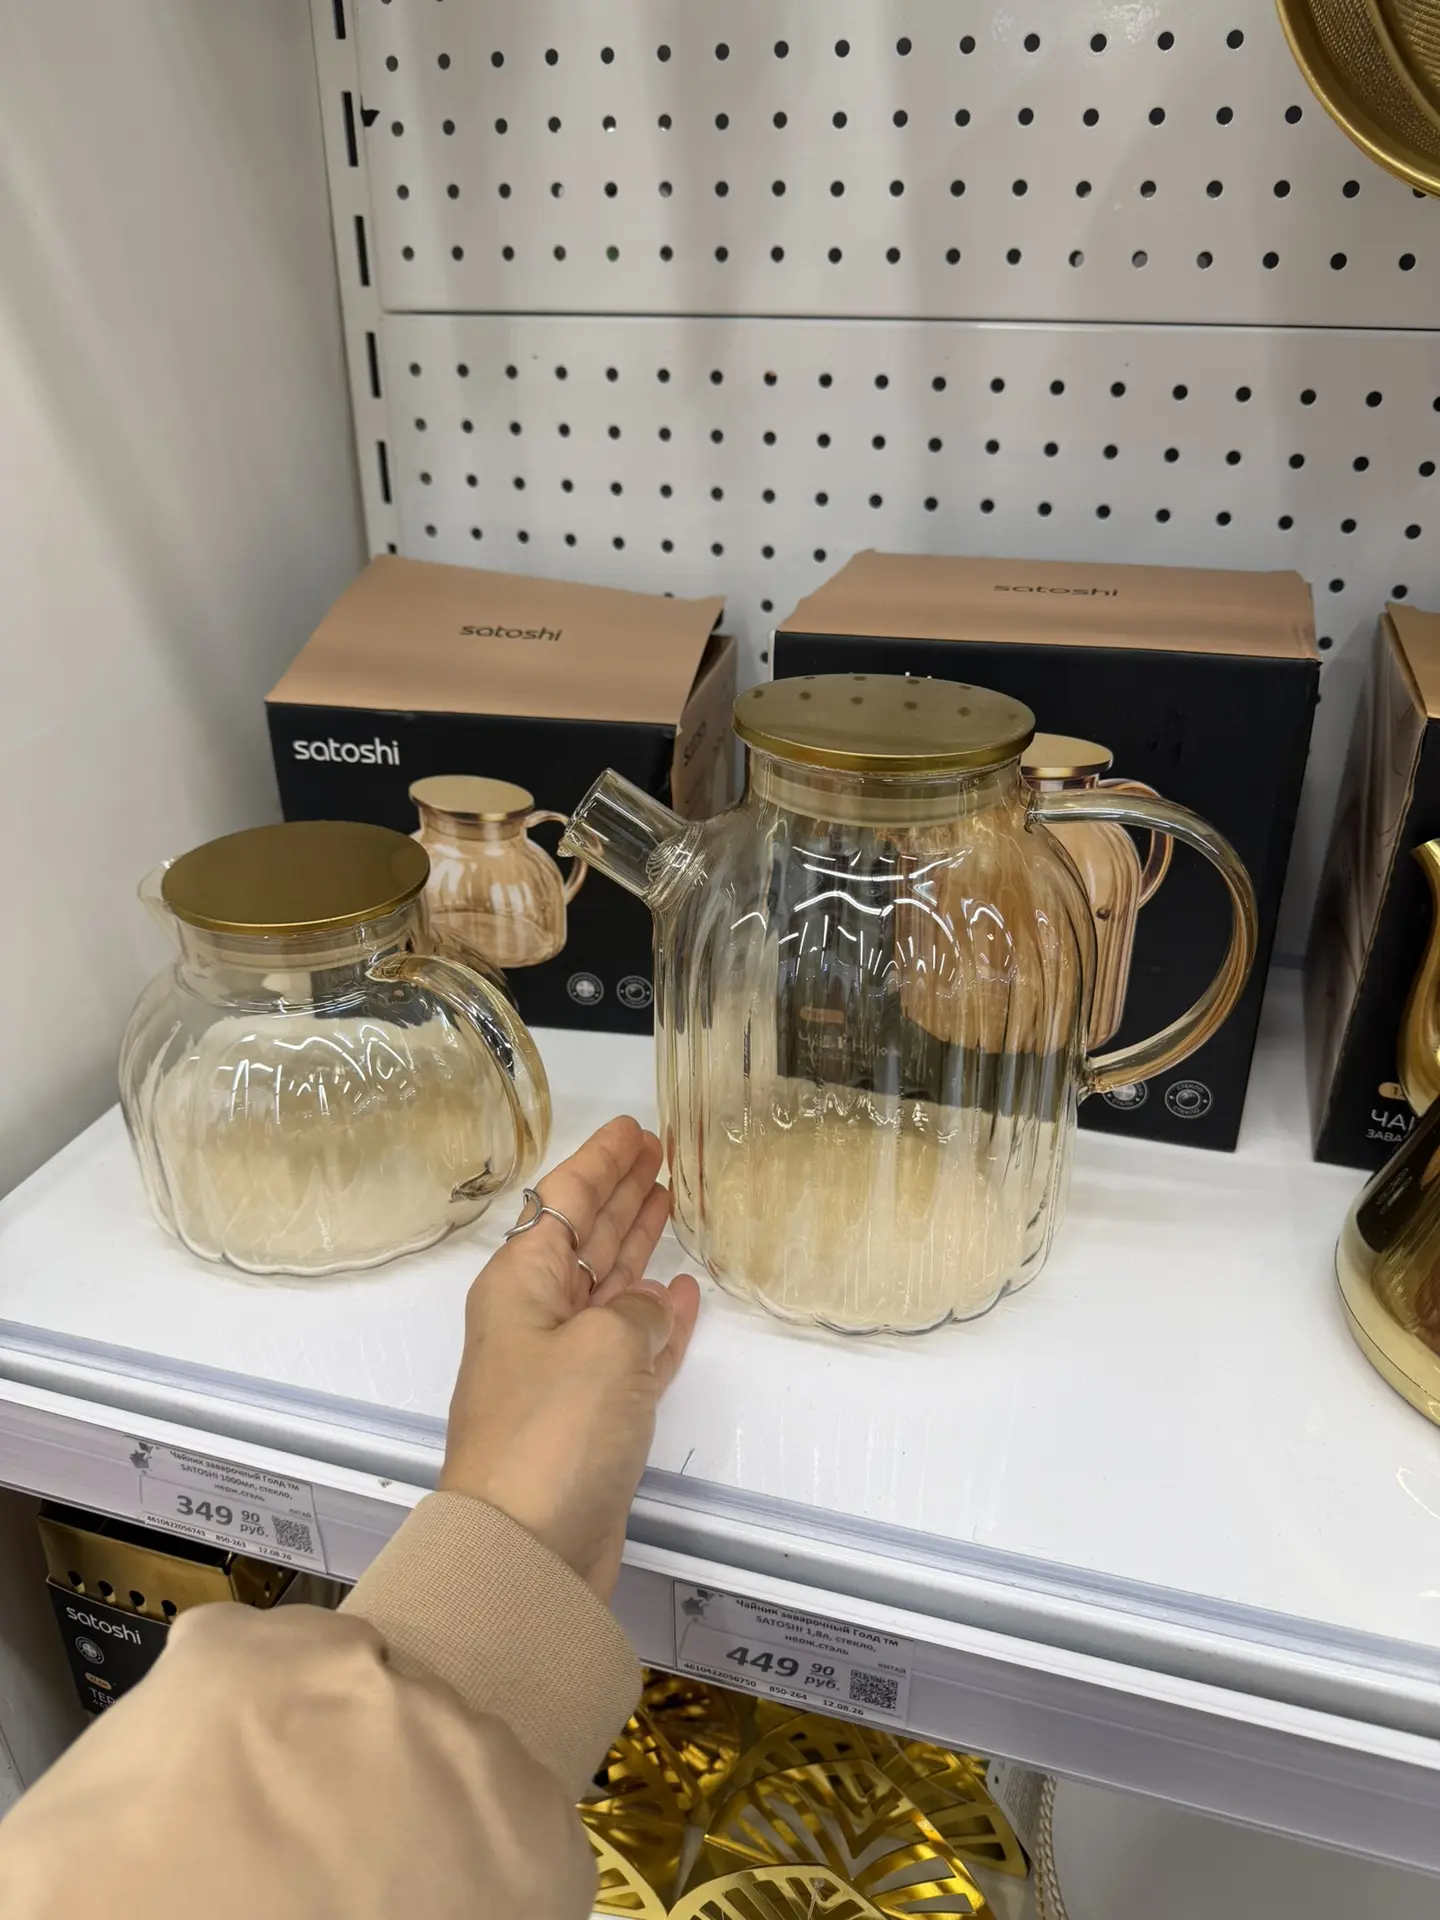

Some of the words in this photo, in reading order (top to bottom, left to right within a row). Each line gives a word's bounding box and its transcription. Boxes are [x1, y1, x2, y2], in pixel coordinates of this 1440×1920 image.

[993, 585, 1118, 597] satoshi
[459, 624, 563, 642] satoshi
[293, 737, 401, 766] satoshi
[1371, 1108, 1416, 1131] ЧА
[1365, 1128, 1403, 1142] ЗАВА
[170, 1451, 204, 1466] Чайник
[205, 1461, 261, 1481] заварочный
[263, 1475, 287, 1489] Голд
[181, 1464, 219, 1479] SATOSHI
[259, 1485, 293, 1500] стекло,
[176, 1495, 233, 1526] 349
[241, 1510, 260, 1523] 90
[215, 1534, 247, 1548] 850-263
[240, 1523, 269, 1538] руб.
[66, 1606, 142, 1645] satoshi
[736, 1599, 778, 1616] Чайник
[781, 1609, 851, 1633] заварочный
[853, 1628, 881, 1644] Голд
[756, 1615, 803, 1632] SATOSHI
[806, 1628, 832, 1643] 1,8л,
[835, 1636, 877, 1652] стекло,
[785, 1634, 850, 1656] нерж.сталь
[726, 1645, 799, 1677] 449
[811, 1662, 835, 1677] 90
[684, 1662, 757, 1688] 4610422056750
[769, 1685, 808, 1701] 850-264
[822, 1699, 864, 1716] 12.08.26
[804, 1675, 840, 1691] руб.
